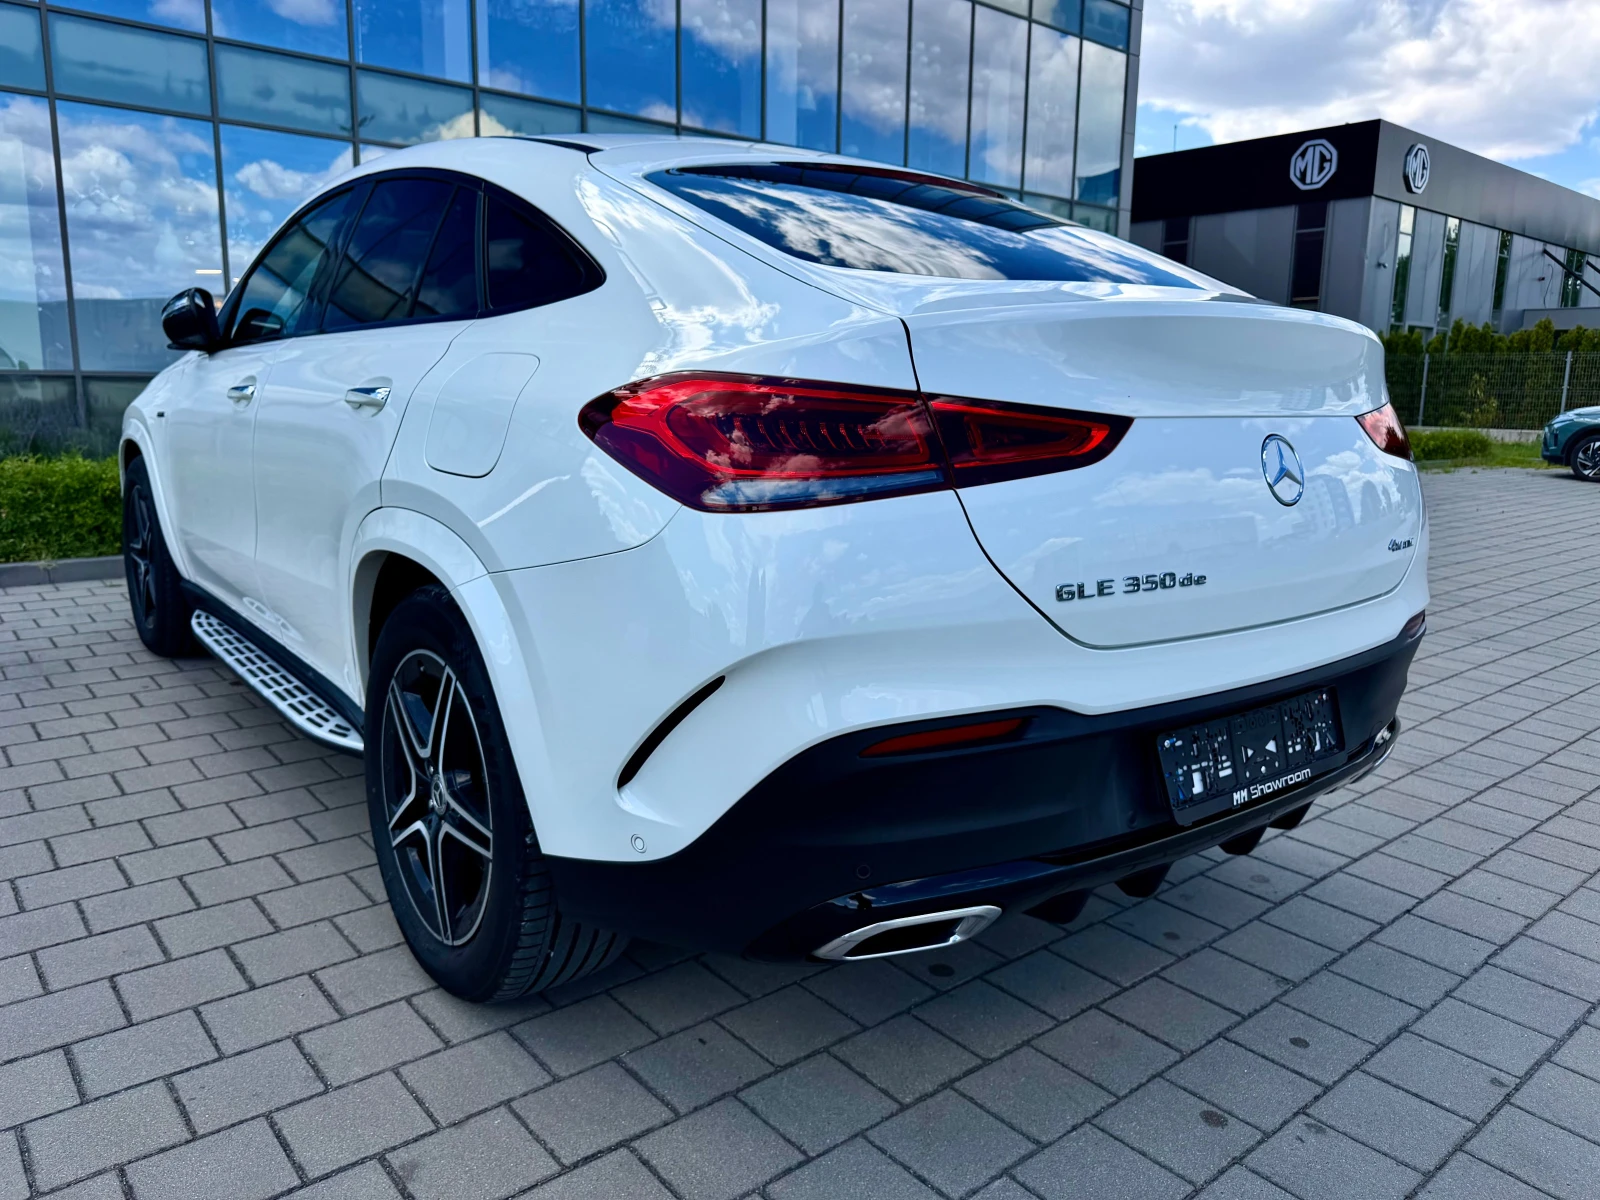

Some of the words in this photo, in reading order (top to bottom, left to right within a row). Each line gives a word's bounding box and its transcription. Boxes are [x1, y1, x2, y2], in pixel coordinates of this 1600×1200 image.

[1294, 144, 1332, 185] MG
[1410, 149, 1428, 188] MG
[1055, 577, 1116, 602] GLE
[1250, 768, 1312, 799] Showroom
